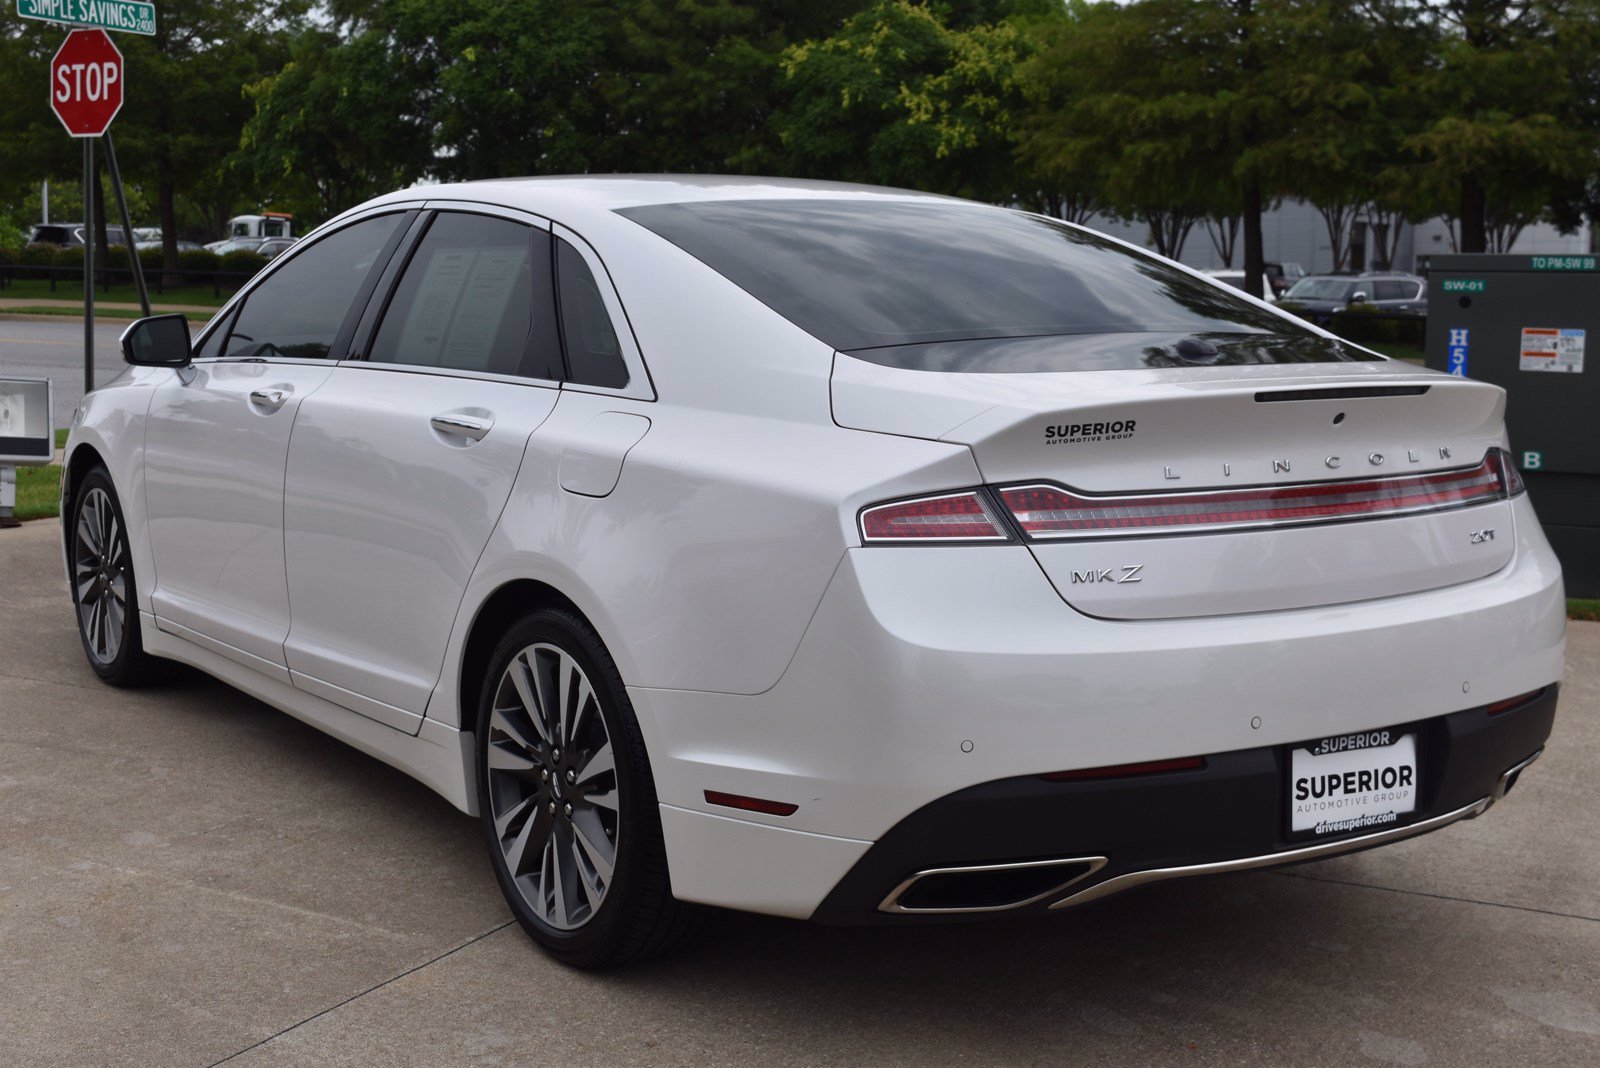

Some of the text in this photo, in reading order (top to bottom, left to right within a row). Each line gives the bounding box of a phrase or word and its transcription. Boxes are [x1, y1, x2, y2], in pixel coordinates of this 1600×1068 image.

[29, 0, 149, 29] SIMPLE SAVINGS DR
[136, 19, 154, 32] 2400
[56, 62, 118, 103] STOP
[1532, 257, 1595, 269] TO PM-SW 99
[1444, 281, 1484, 291] SW-01
[1045, 420, 1136, 438] SUPERIOR
[1046, 433, 1134, 445] AUTOMOTIVE GROUP
[1164, 446, 1452, 480] LINCOLN
[1524, 451, 1541, 469] B
[1071, 564, 1144, 584] MKZ
[1321, 731, 1390, 754] SUPERIOR
[1295, 764, 1413, 801] SUPERIOR
[1296, 790, 1409, 814] AUTOMOTIVE GROUP
[1315, 812, 1397, 835] drivesuperior.com
